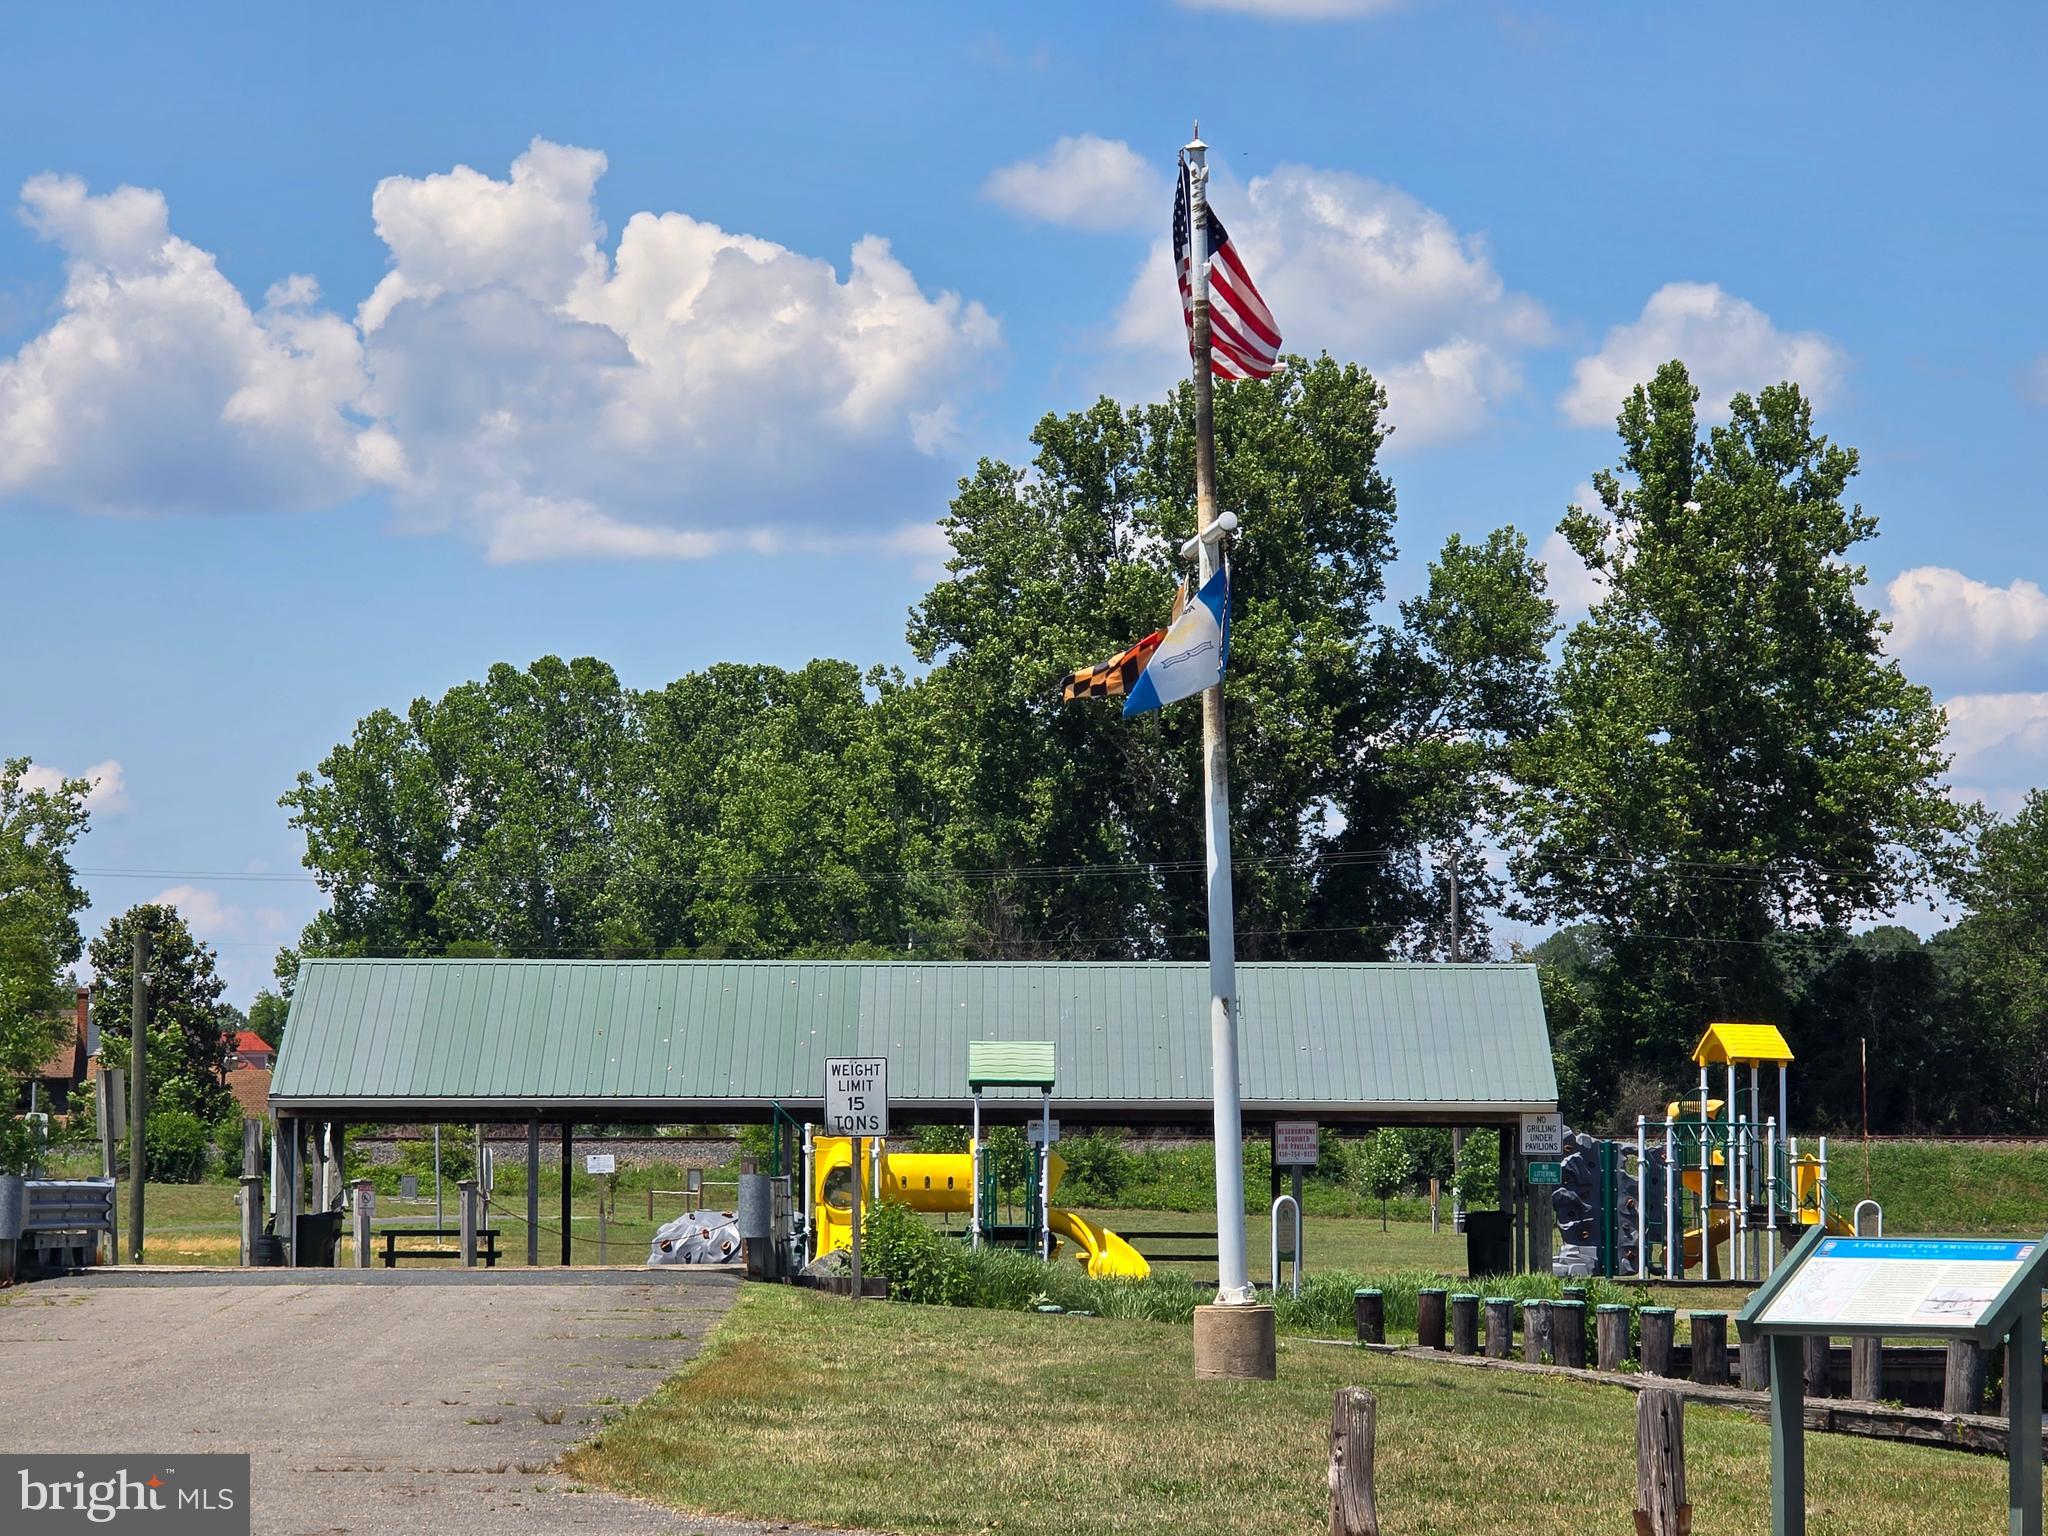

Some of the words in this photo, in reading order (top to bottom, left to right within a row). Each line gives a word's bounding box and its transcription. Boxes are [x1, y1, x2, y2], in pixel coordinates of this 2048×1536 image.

[831, 1064, 881, 1076] WEIGHT
[838, 1080, 873, 1091] LIMIT
[847, 1096, 865, 1111] 15
[833, 1115, 879, 1131] TONS
[1536, 1115, 1547, 1123] NO
[1526, 1124, 1557, 1133] GRILLING
[1530, 1133, 1553, 1142] UNDER
[1525, 1142, 1558, 1151] PAVILIONS
[1942, 1243, 2008, 1251] SMUGGLERS
